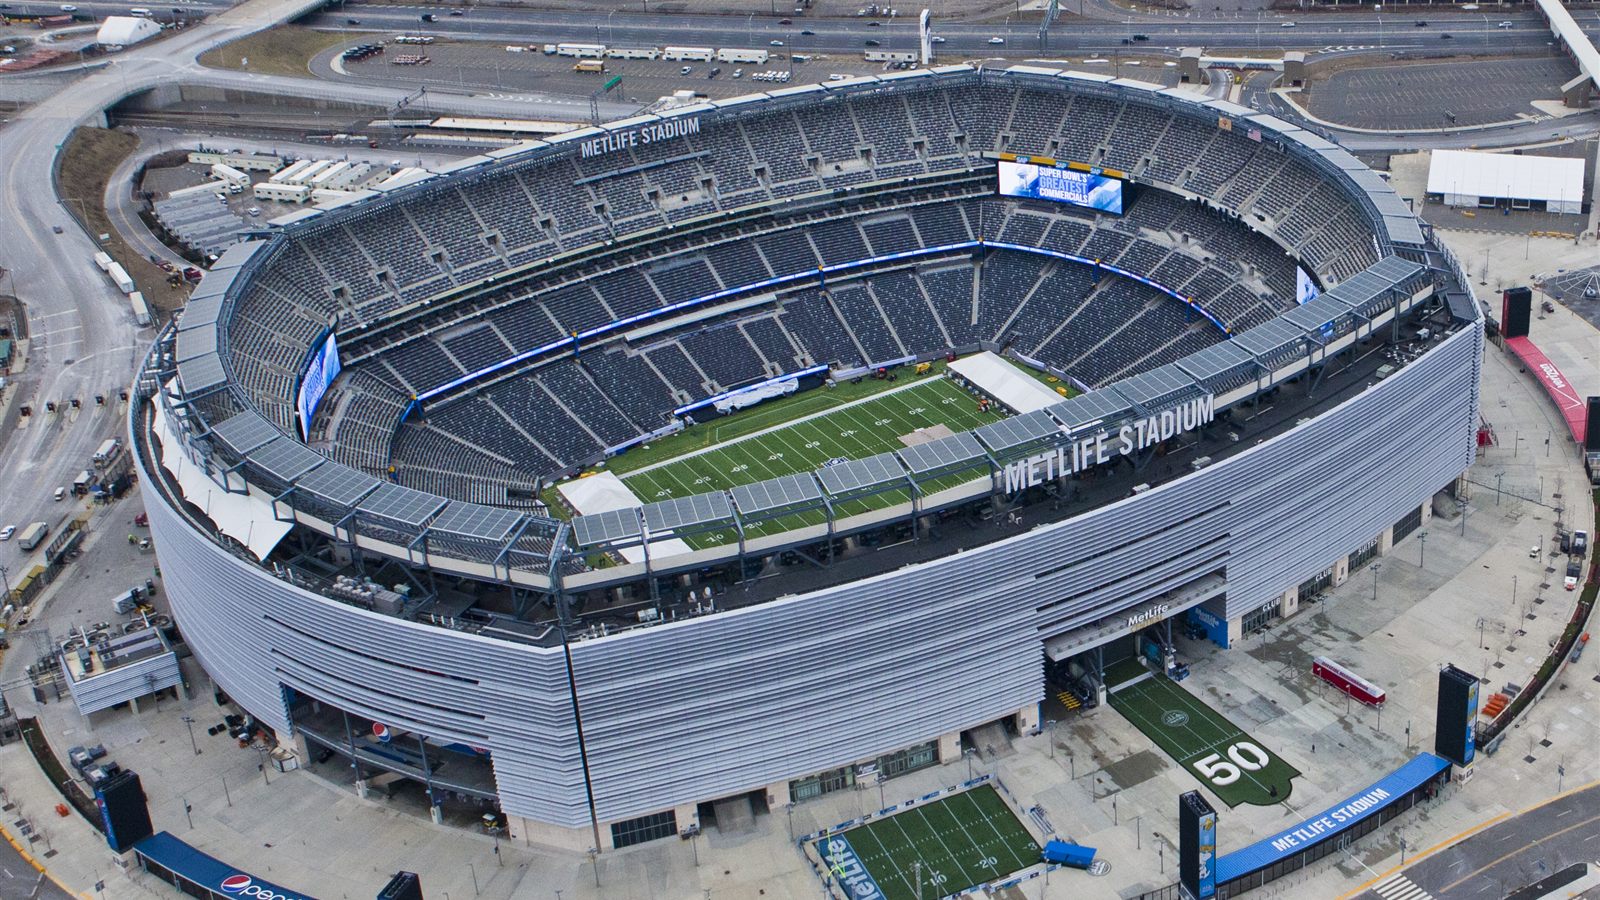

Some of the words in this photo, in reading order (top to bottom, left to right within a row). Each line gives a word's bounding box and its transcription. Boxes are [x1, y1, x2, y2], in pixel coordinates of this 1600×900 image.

[581, 130, 638, 158] METLIFE
[641, 117, 700, 144] STADIUM
[1039, 166, 1062, 179] SUPER
[1062, 170, 1088, 182] BOWL'S
[1040, 176, 1088, 195] GREATEST
[1040, 187, 1088, 203] COMMERCIALS
[1005, 432, 1110, 494] METLIFE
[1119, 393, 1215, 456] STADIUM
[1357, 536, 1379, 556] SUITES
[1315, 567, 1333, 582] CLUB
[1262, 597, 1281, 612] CLUB
[1127, 604, 1169, 627] MetLife
[1192, 741, 1270, 786] 50
[1271, 816, 1337, 852] METLIFE
[1331, 787, 1391, 822] STADIUM
[979, 857, 998, 869] 20
